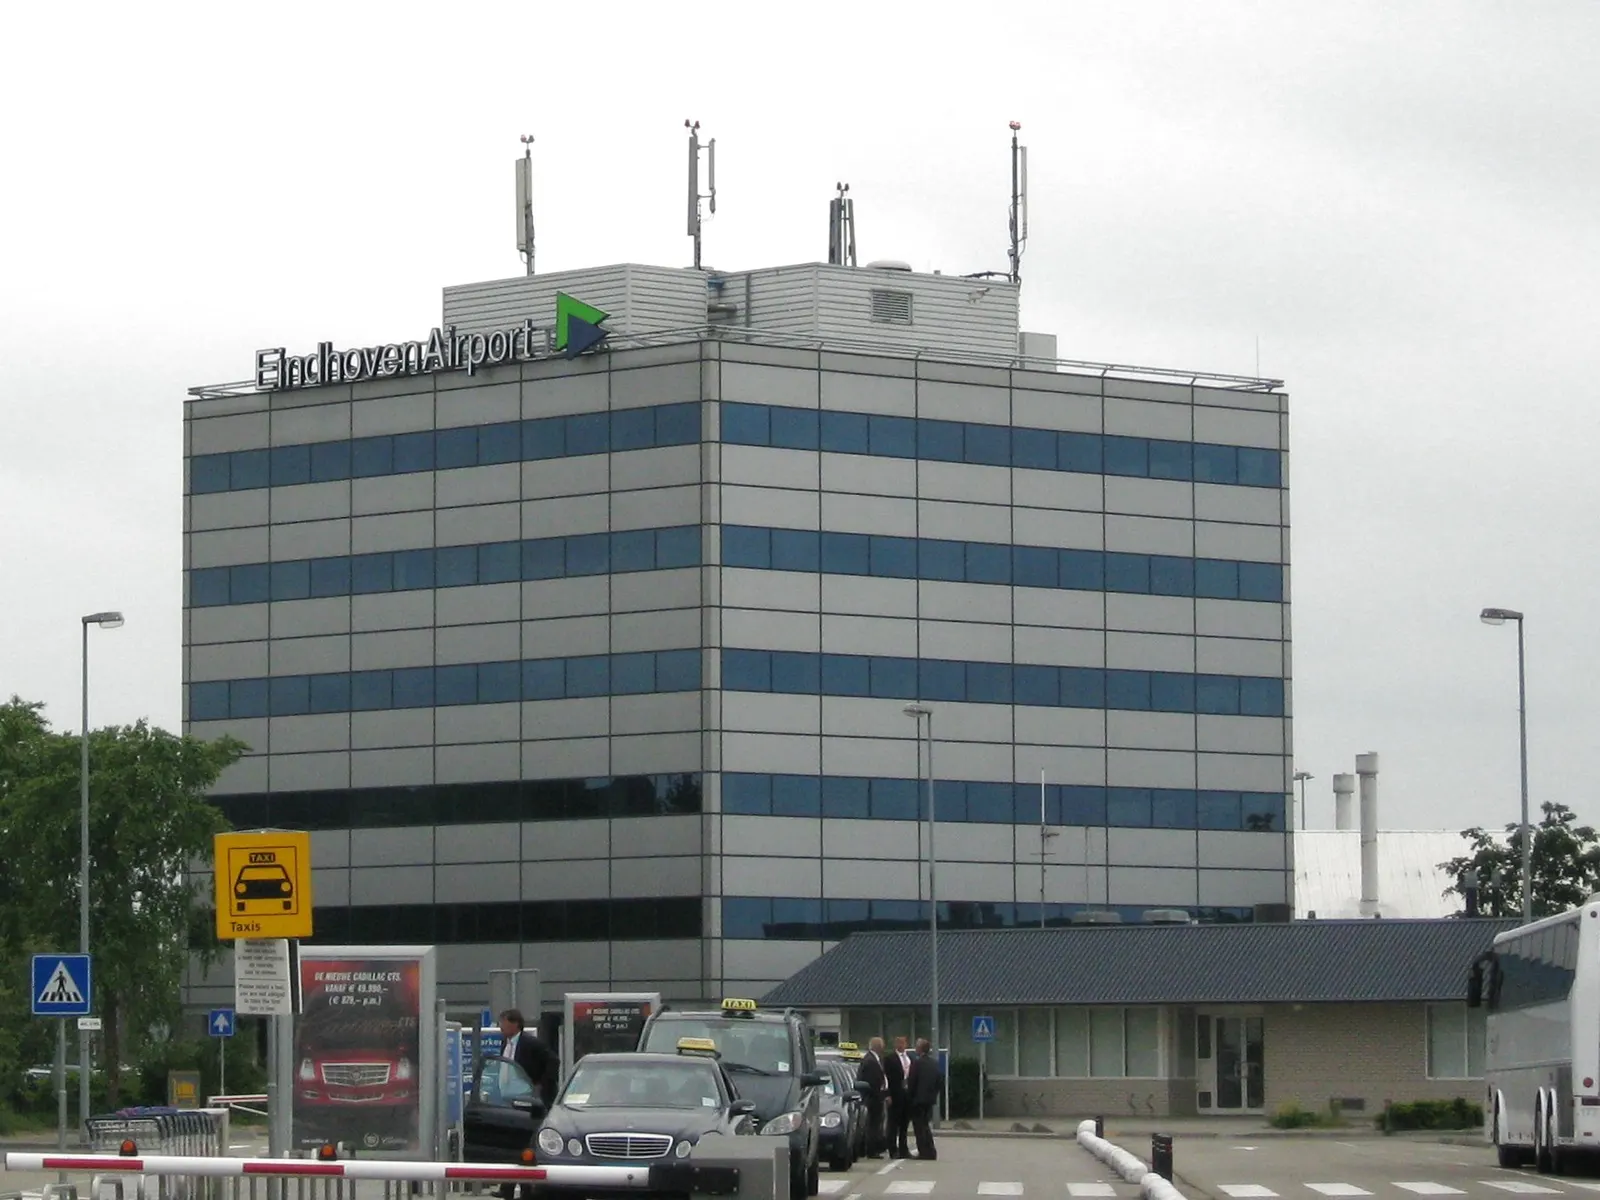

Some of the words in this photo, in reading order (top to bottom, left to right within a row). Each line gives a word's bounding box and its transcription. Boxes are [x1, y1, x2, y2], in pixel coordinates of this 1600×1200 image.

[251, 854, 274, 862] TAXI
[230, 921, 261, 932] Taxis
[325, 972, 351, 981] NIEUWE
[353, 972, 386, 981] CADILLAC
[725, 1000, 753, 1009] TAXI
